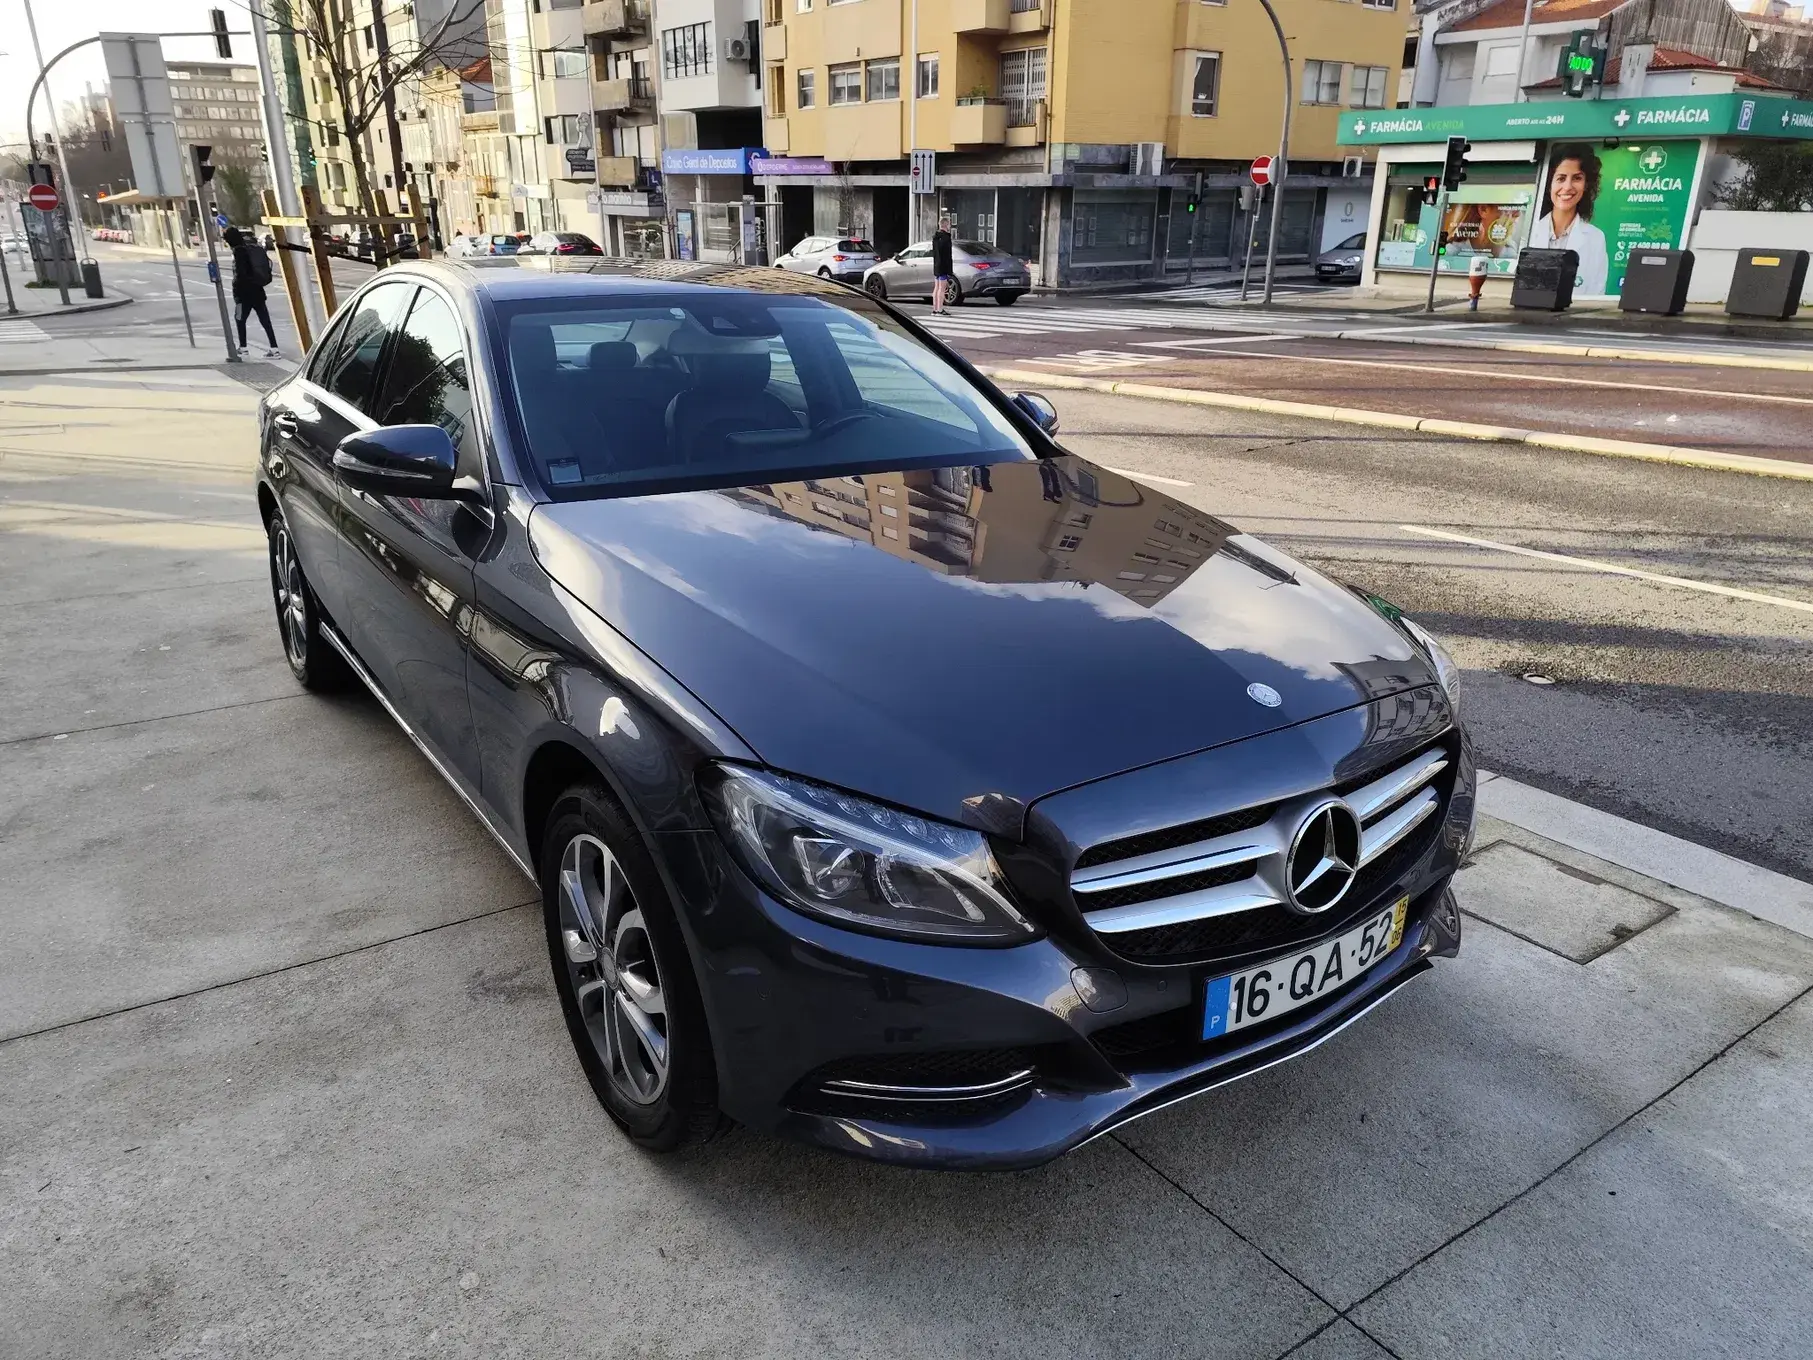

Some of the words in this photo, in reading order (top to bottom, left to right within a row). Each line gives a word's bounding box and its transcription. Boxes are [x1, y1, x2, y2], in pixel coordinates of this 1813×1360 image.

[1506, 117, 1530, 126] ABERTO
[1546, 115, 1565, 125] 24H
[1637, 106, 1710, 124] FARMÁCIA
[1790, 112, 1813, 128] FARMÁ
[1370, 118, 1423, 133] FARMÁCIA
[1425, 119, 1465, 131] AVENIDA
[1614, 176, 1682, 191] FARMÁCIA
[1627, 194, 1664, 203] AVENIDA
[1452, 228, 1479, 238] Avène
[1210, 1015, 1221, 1030] P
